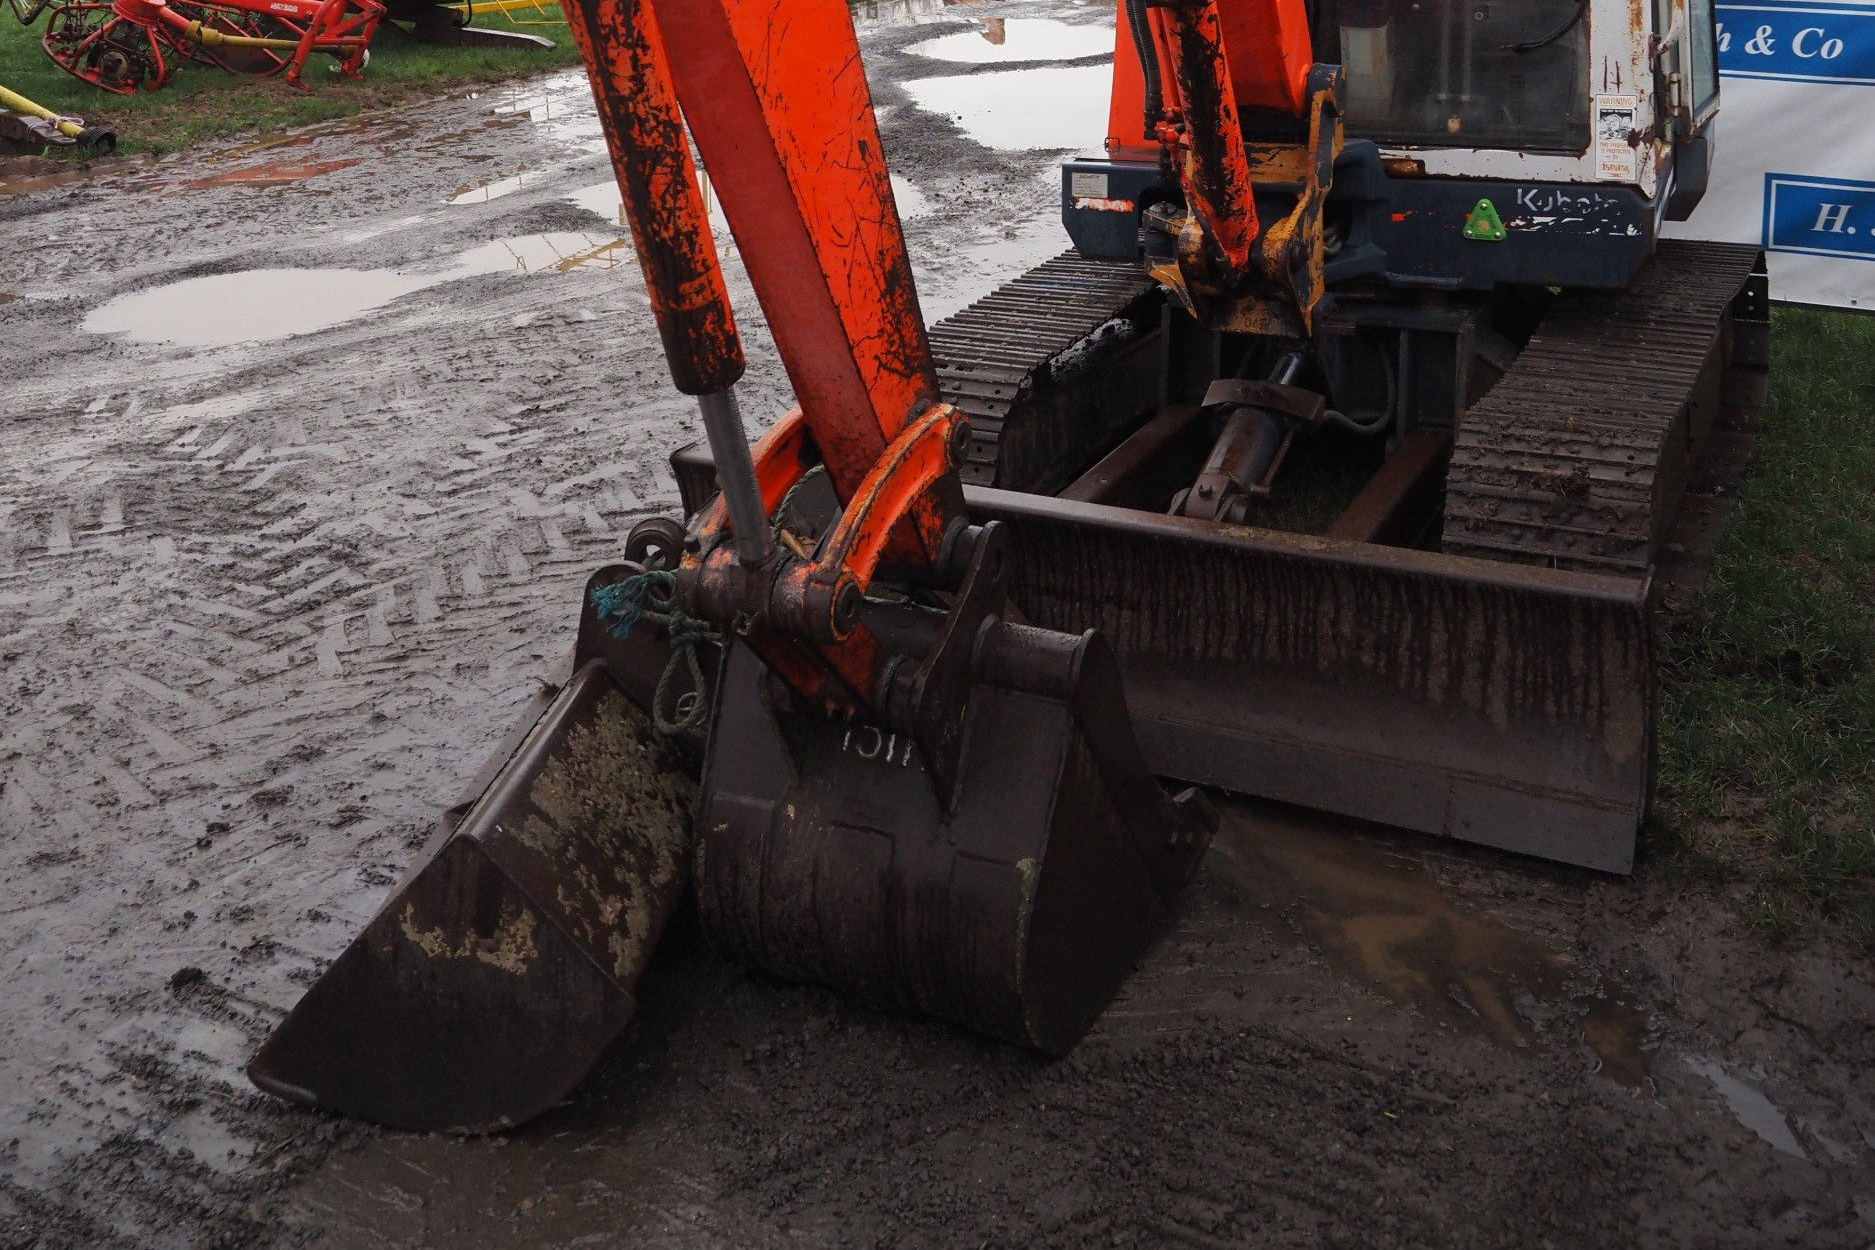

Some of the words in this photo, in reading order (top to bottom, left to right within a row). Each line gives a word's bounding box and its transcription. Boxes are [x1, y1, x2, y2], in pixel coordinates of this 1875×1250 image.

[1744, 25, 1776, 56] &
[1792, 27, 1844, 60] Co
[1599, 96, 1632, 106] WARNING
[1809, 203, 1857, 235] H.
